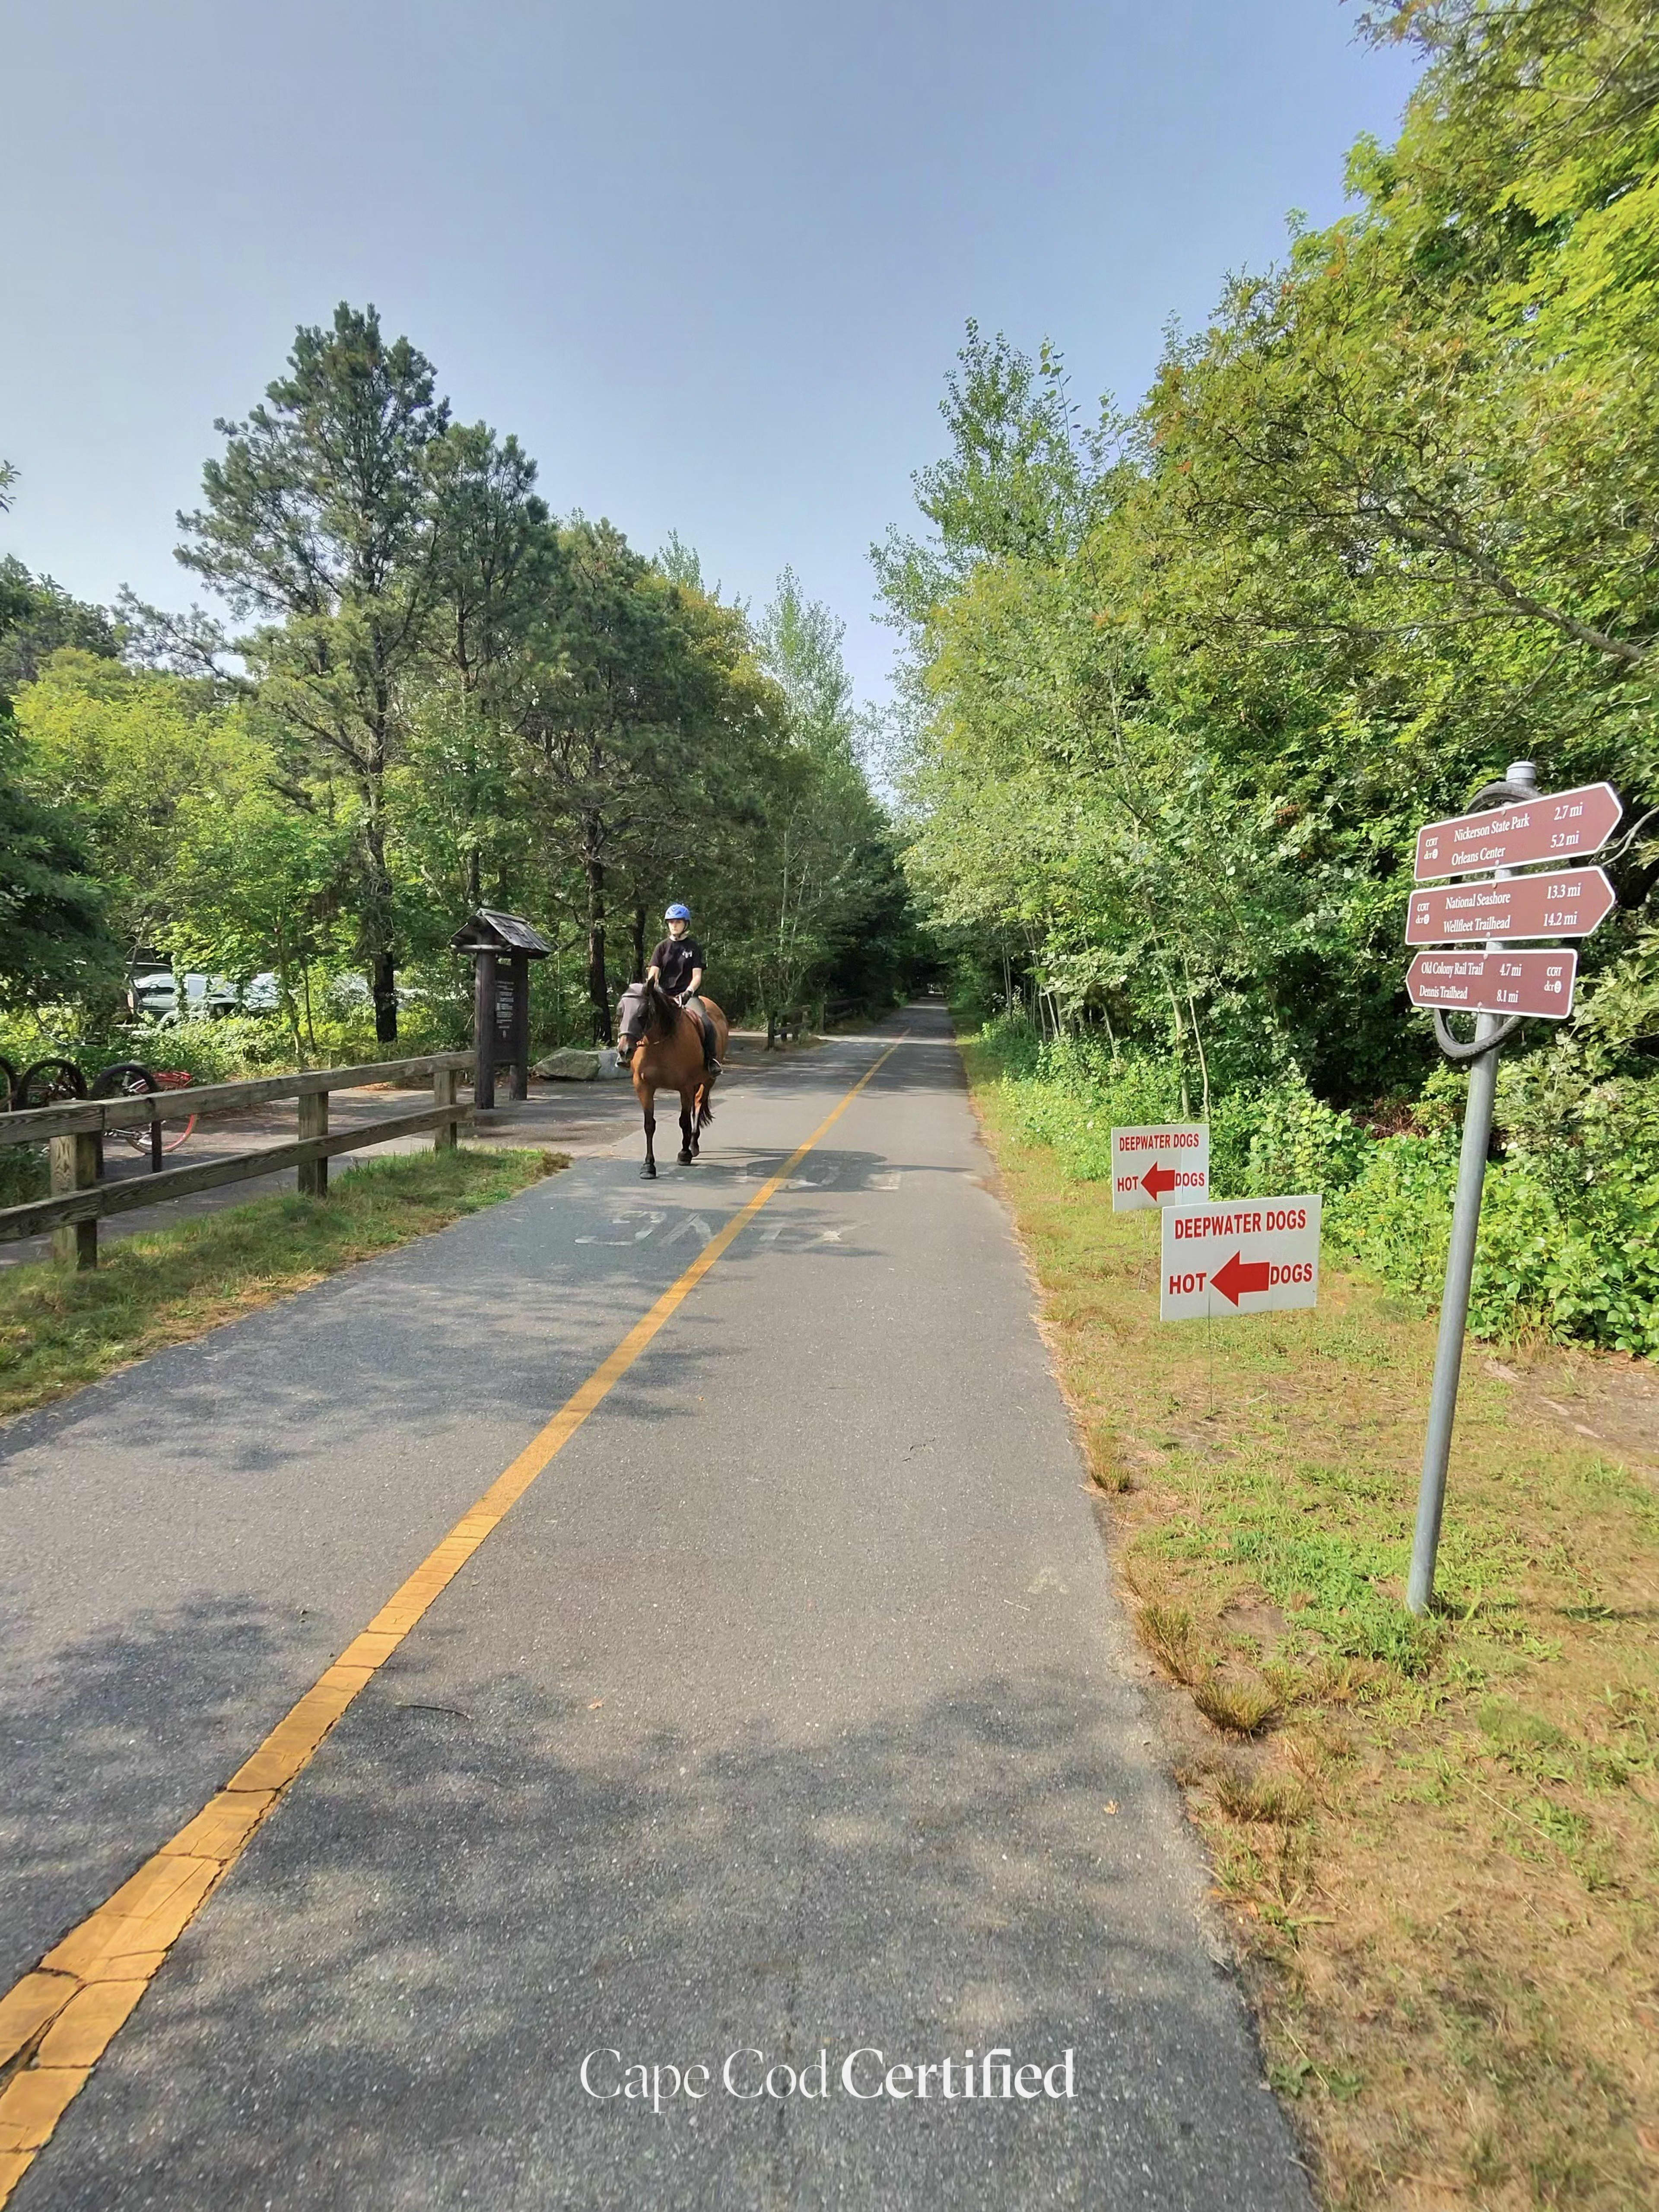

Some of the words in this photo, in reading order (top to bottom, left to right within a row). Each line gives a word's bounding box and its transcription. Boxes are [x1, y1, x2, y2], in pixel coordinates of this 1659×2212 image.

[1453, 826, 1490, 842] Nickerson
[1491, 820, 1510, 834] State
[1511, 813, 1530, 830] Park
[1554, 805, 1570, 820] 2.7
[1569, 802, 1583, 817] mi
[1451, 852, 1479, 866] Orleans
[1480, 847, 1506, 861] Center
[1550, 833, 1565, 849] 5.2
[1565, 830, 1580, 845] mi
[1445, 893, 1476, 909] National
[1476, 891, 1511, 906] Seashore
[1547, 884, 1566, 899] 13.3
[1567, 882, 1582, 897] mi
[1417, 903, 1430, 912] CCRT
[1443, 918, 1473, 933] Wellfleet
[1475, 915, 1511, 931] Trailhead
[1543, 912, 1563, 927] 14.2
[1563, 911, 1578, 925] mi
[1421, 961, 1433, 974] Old
[1433, 961, 1454, 979] Colony
[1454, 962, 1467, 975] Rail
[1468, 962, 1484, 976] Trail
[1500, 963, 1511, 976] 4.7
[1511, 963, 1522, 976] mi
[1546, 966, 1562, 977] CCRT
[1419, 985, 1440, 998] Dennis
[1440, 985, 1468, 999] Trailhead
[1497, 989, 1507, 1002] 8.1
[1508, 990, 1519, 1003] mi
[1119, 1134, 1171, 1151] DEEPWATER
[1173, 1133, 1199, 1148] DOGS
[1117, 1176, 1139, 1192] HOT
[1175, 1173, 1205, 1187] DOGS
[1175, 1212, 1262, 1239] DEEPWATER
[1266, 1209, 1306, 1231] DOGS
[1169, 1272, 1207, 1295] HOT
[1270, 1263, 1313, 1285] DOGS
